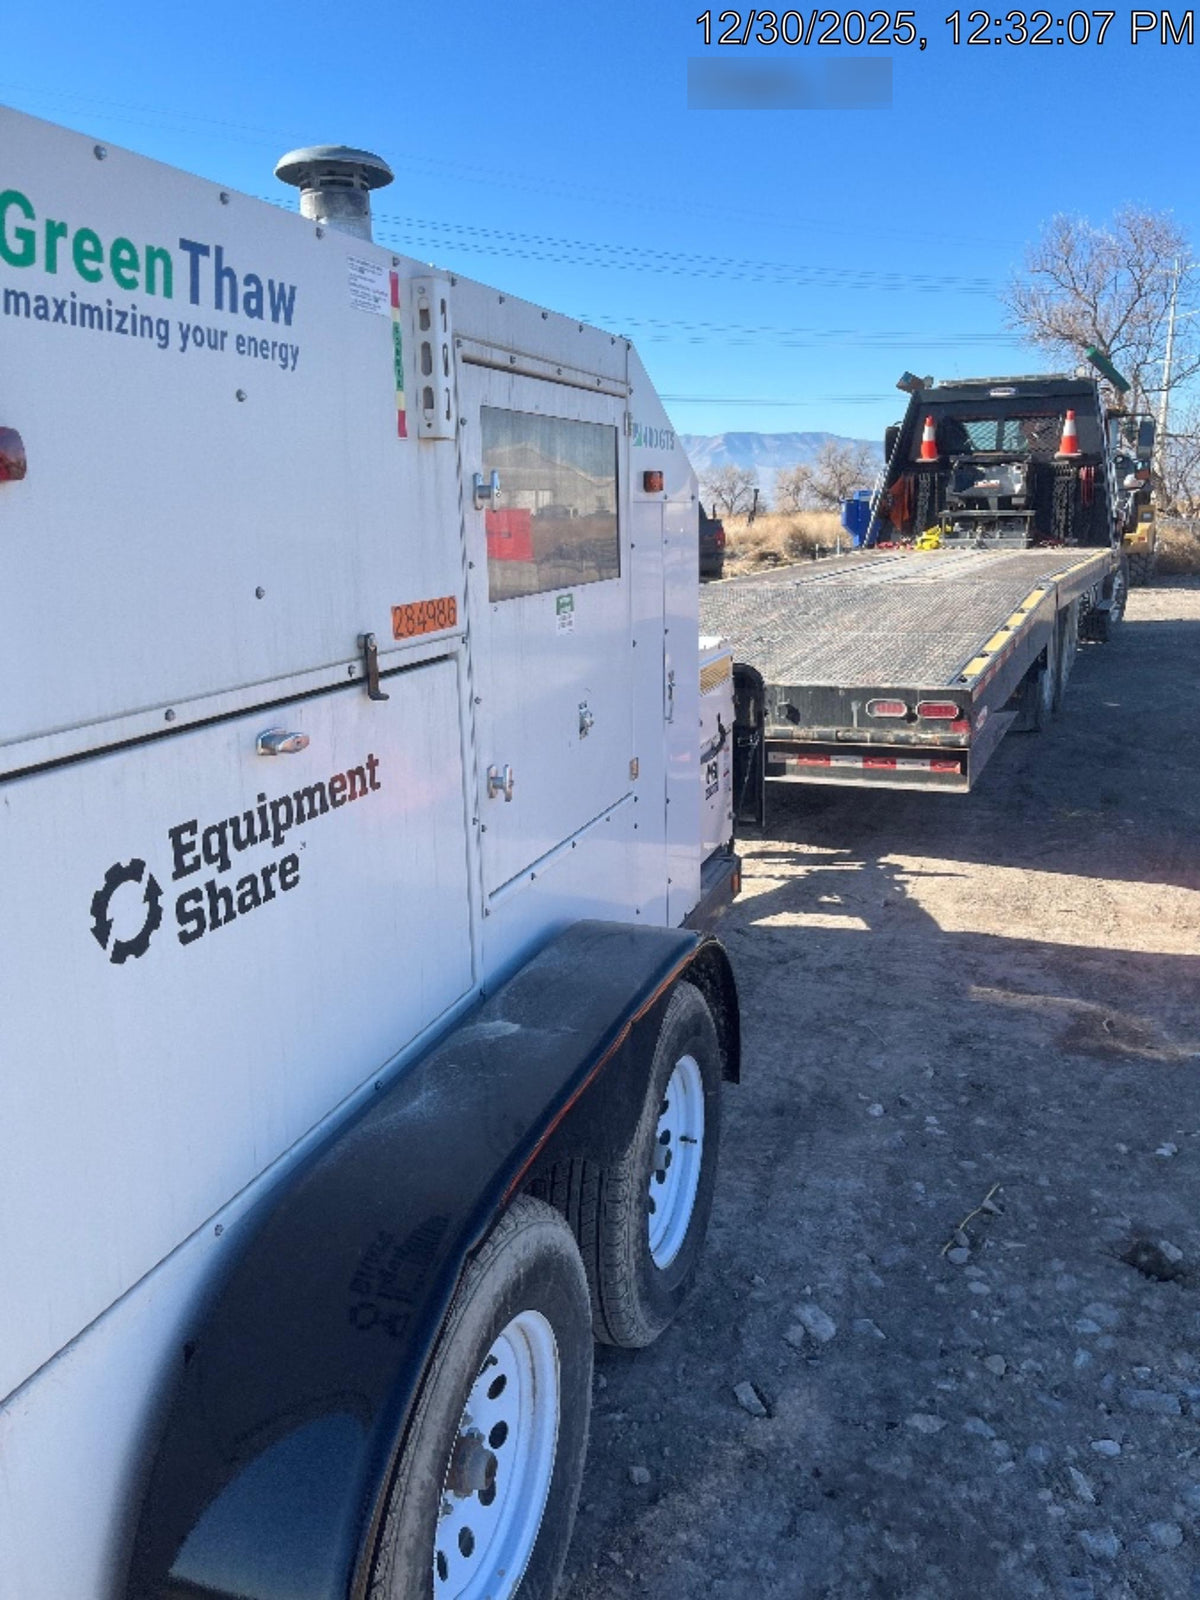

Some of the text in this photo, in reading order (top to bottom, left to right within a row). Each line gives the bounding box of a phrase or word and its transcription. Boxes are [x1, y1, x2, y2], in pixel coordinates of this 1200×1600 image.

[3, 288, 300, 372] maximizing your energy
[393, 597, 457, 637] 284986
[168, 754, 381, 881] Equipment
[175, 853, 301, 945] Share
